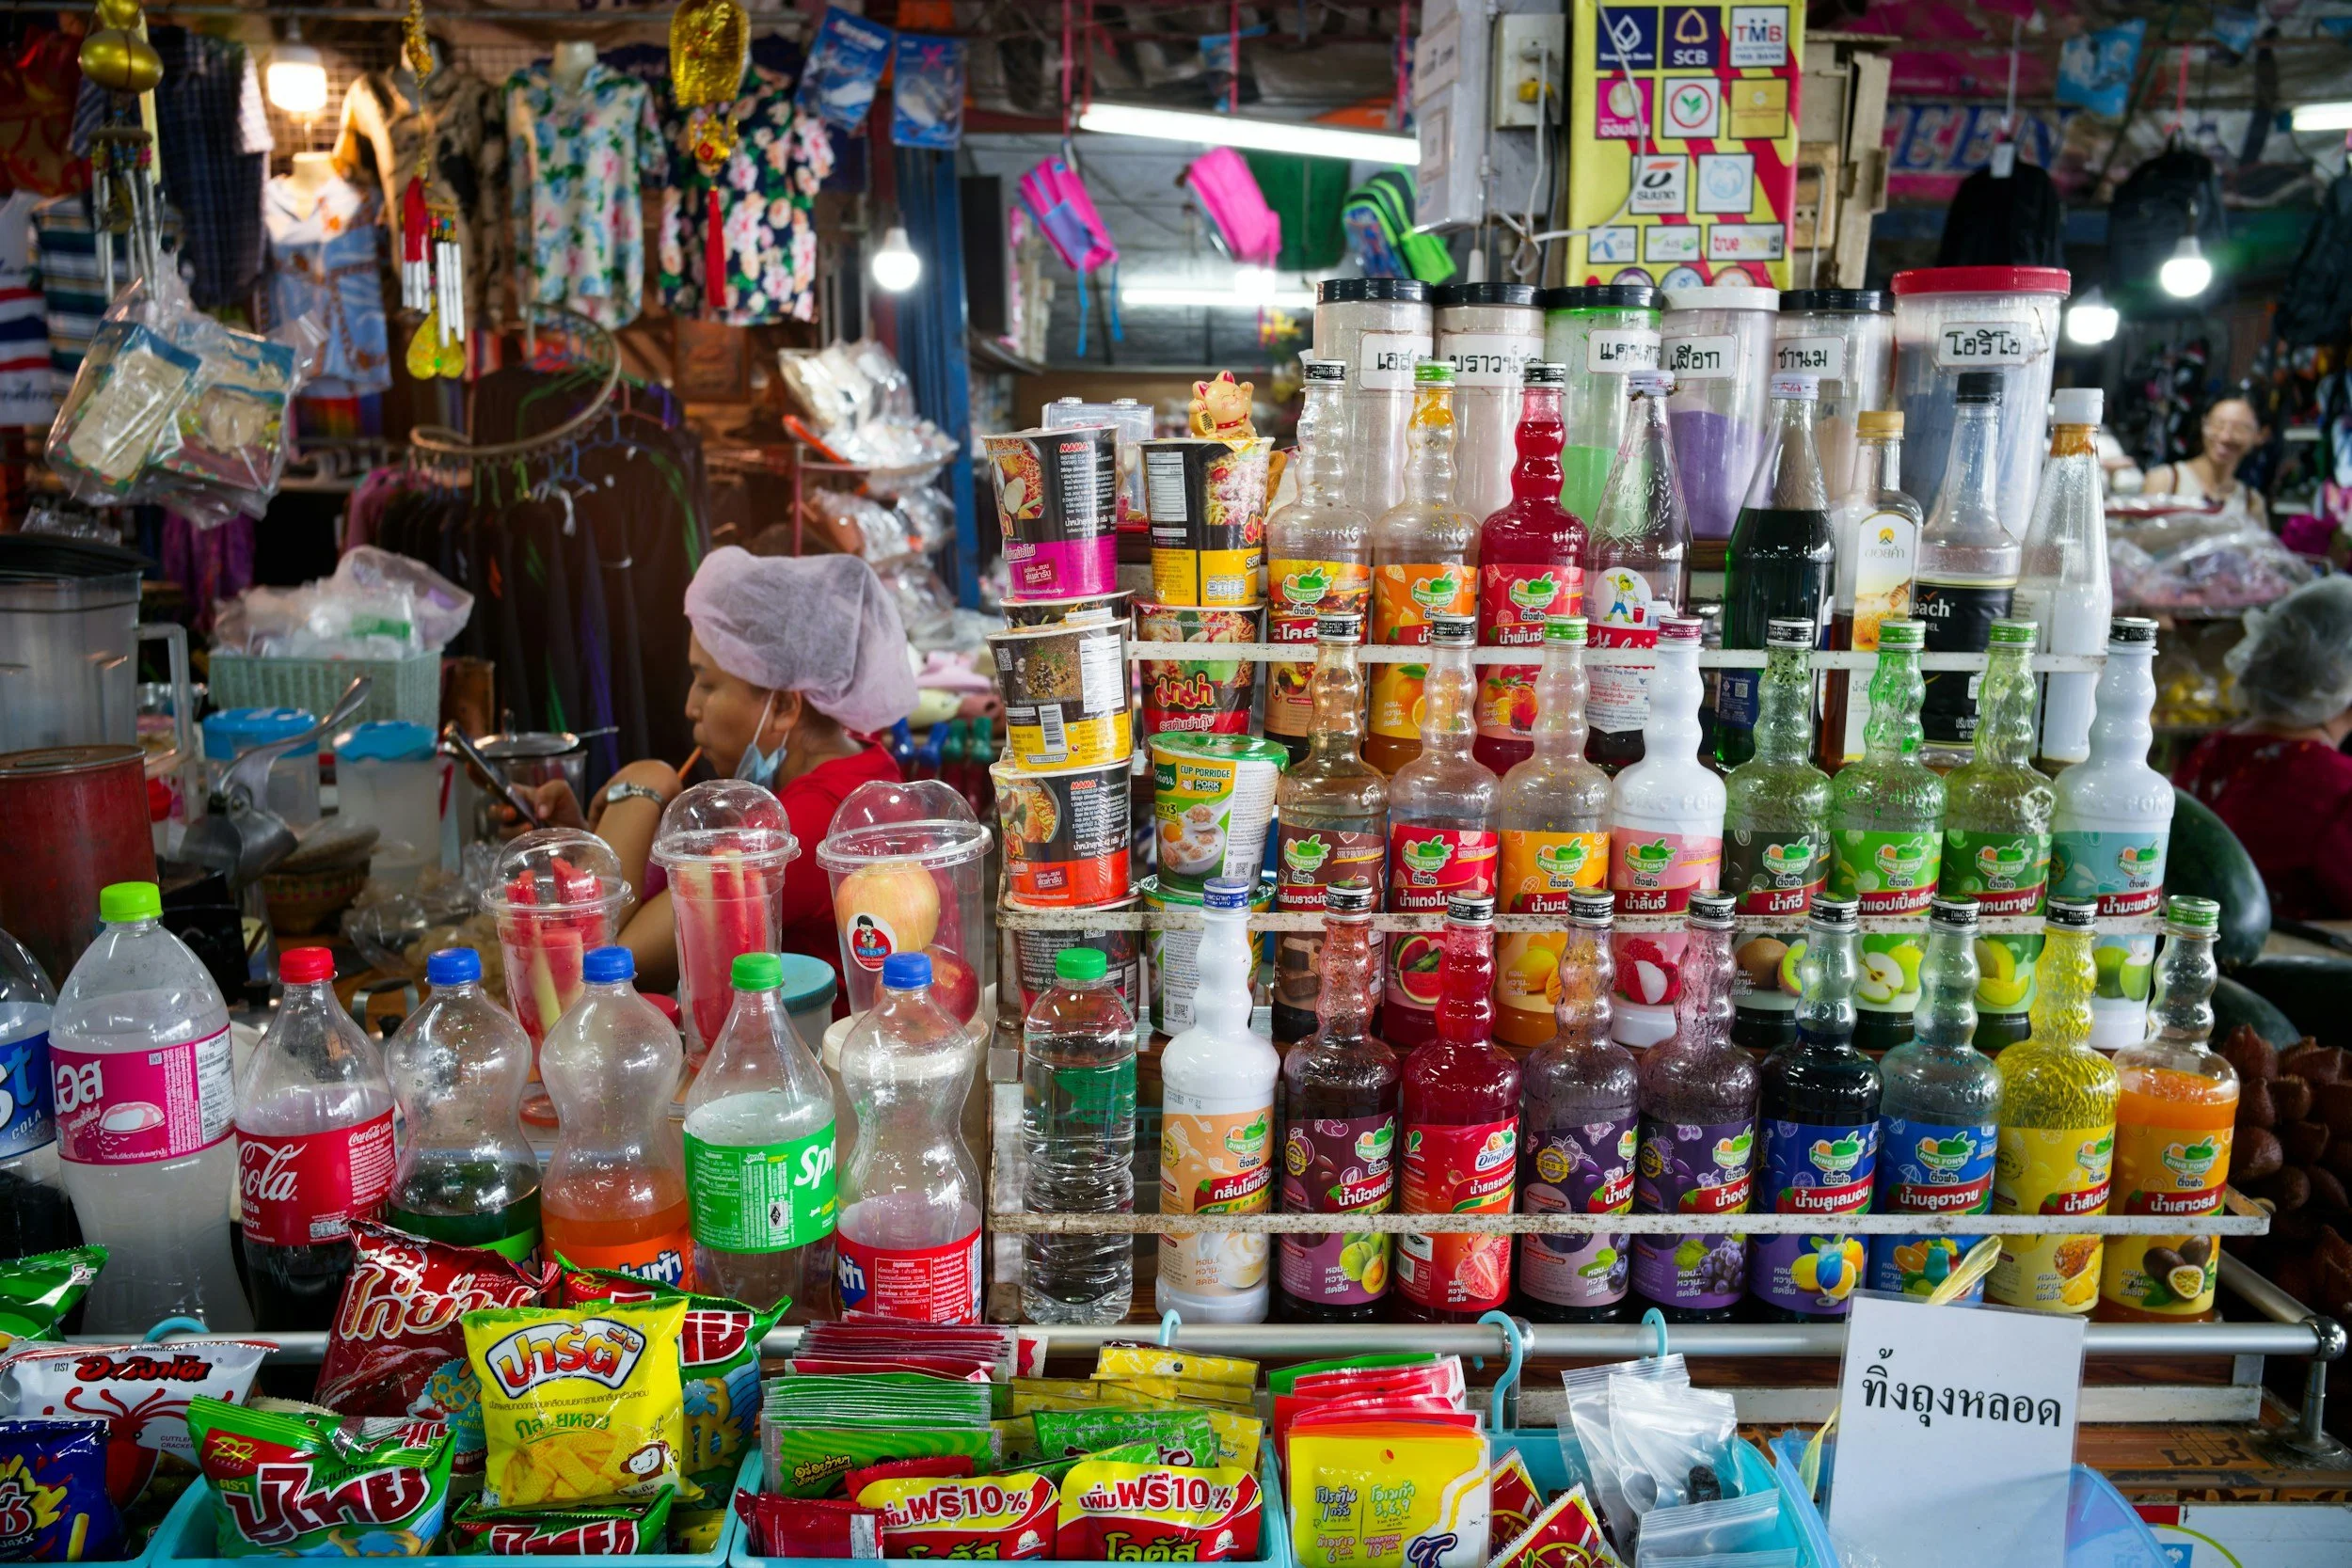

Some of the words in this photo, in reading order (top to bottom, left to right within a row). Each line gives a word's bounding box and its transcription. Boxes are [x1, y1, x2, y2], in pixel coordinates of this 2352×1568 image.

[1736, 25, 1783, 42] TMB
[1673, 50, 1708, 65] SCB
[1713, 234, 1740, 252] true
[1669, 344, 1720, 371] เผือก
[1777, 348, 1827, 370] ชานม
[1285, 588, 1300, 598] DING
[1301, 591, 1321, 600] FONG
[1415, 593, 1431, 602] DING
[1433, 594, 1451, 603] FONG
[1512, 594, 1529, 604] DING
[1531, 595, 1550, 605] FONG
[1294, 604, 1316, 616] ติ่งฟง
[1155, 673, 1214, 709] มาม่า
[1181, 765, 1193, 775] CUP
[1195, 767, 1231, 778] PORRIDGE
[1071, 780, 1097, 790] MAMA
[1196, 780, 1220, 788] PORK
[1286, 854, 1299, 864] DING
[1300, 857, 1319, 866] FONG
[1405, 855, 1420, 865] DING
[1422, 858, 1441, 868] FONG
[1539, 860, 1556, 869] DING
[1559, 862, 1581, 871] FONG
[1627, 857, 1643, 869] DING
[1644, 861, 1664, 870] FONG
[1767, 859, 1785, 869] DING
[1788, 862, 1806, 871] FONG
[1879, 859, 1897, 869] DING
[1899, 862, 1919, 871] FONG
[1979, 861, 1995, 871] DING
[1998, 863, 2021, 873] FONG
[2120, 861, 2136, 871] DING
[2138, 863, 2157, 873] FONG
[1293, 869, 1314, 884] ติ่งฟง
[1413, 870, 1438, 885] ติ่งฟง
[1549, 875, 1575, 888] ติ่งฟง
[1634, 873, 1659, 888] ติ่งฟง
[1776, 874, 1802, 887] ติ่งฟง
[1888, 874, 1914, 887] ติ่งฟง
[1989, 876, 2014, 889] ติ่งฟง
[2128, 877, 2150, 889] ติ่งฟง
[2103, 895, 2159, 914] น้ำมะพร้าว
[11, 1109, 42, 1140] COLA
[348, 1124, 381, 1148] Coca-Cola
[1228, 1141, 1247, 1150] DING
[1248, 1137, 1265, 1149] FONG
[1359, 1147, 1375, 1157] DING
[1478, 1148, 1502, 1166] Ding
[1716, 1153, 1733, 1163] DING
[1734, 1150, 1750, 1162] FONG
[1239, 1156, 1261, 1168] ติ่งฟง
[1812, 1155, 1833, 1165] DING
[1835, 1157, 1856, 1165] FONG
[1919, 1153, 1940, 1165] DING
[1941, 1154, 1964, 1165] FONG
[2079, 1156, 2096, 1165] DING
[2165, 1156, 2185, 1168] DING
[2187, 1158, 2211, 1169] FONG
[1368, 1160, 1389, 1175] ติ่งฟง
[1725, 1166, 1746, 1180] ติ่งฟง
[1823, 1170, 1851, 1183] ติ่งฟง
[1929, 1168, 1959, 1183] ติ่งฟง
[2089, 1170, 2106, 1183] ติ่งฟง
[2176, 1173, 2204, 1189] ติ่งฟง
[1715, 1183, 1749, 1208] น้ำองุ่น
[1795, 1185, 1869, 1211] น้ำบลูเลมอน
[1899, 1186, 1979, 1212] น้ำบลูฮาวาย
[2151, 1195, 2217, 1213] น้ำเสาวรส
[497, 1323, 640, 1387] ปาร์ตี้
[54, 1362, 69, 1372] ตรา
[1862, 1348, 2061, 1428] ทิ้งถุงหลอด
[515, 1413, 611, 1439] กลยหอม
[218, 1478, 249, 1493] ตรา
[1370, 1481, 1416, 1502] โอเมก้า
[1315, 1484, 1358, 1505] โปรตีน
[222, 1463, 432, 1547] ปูไทย
[1330, 1504, 1351, 1517] กรัม
[1104, 1531, 1201, 1561] โลตัส
[1316, 1533, 1356, 1548] ดีเอชเอ
[1327, 1548, 1336, 1564] 6
[1366, 1544, 1383, 1559] 18
